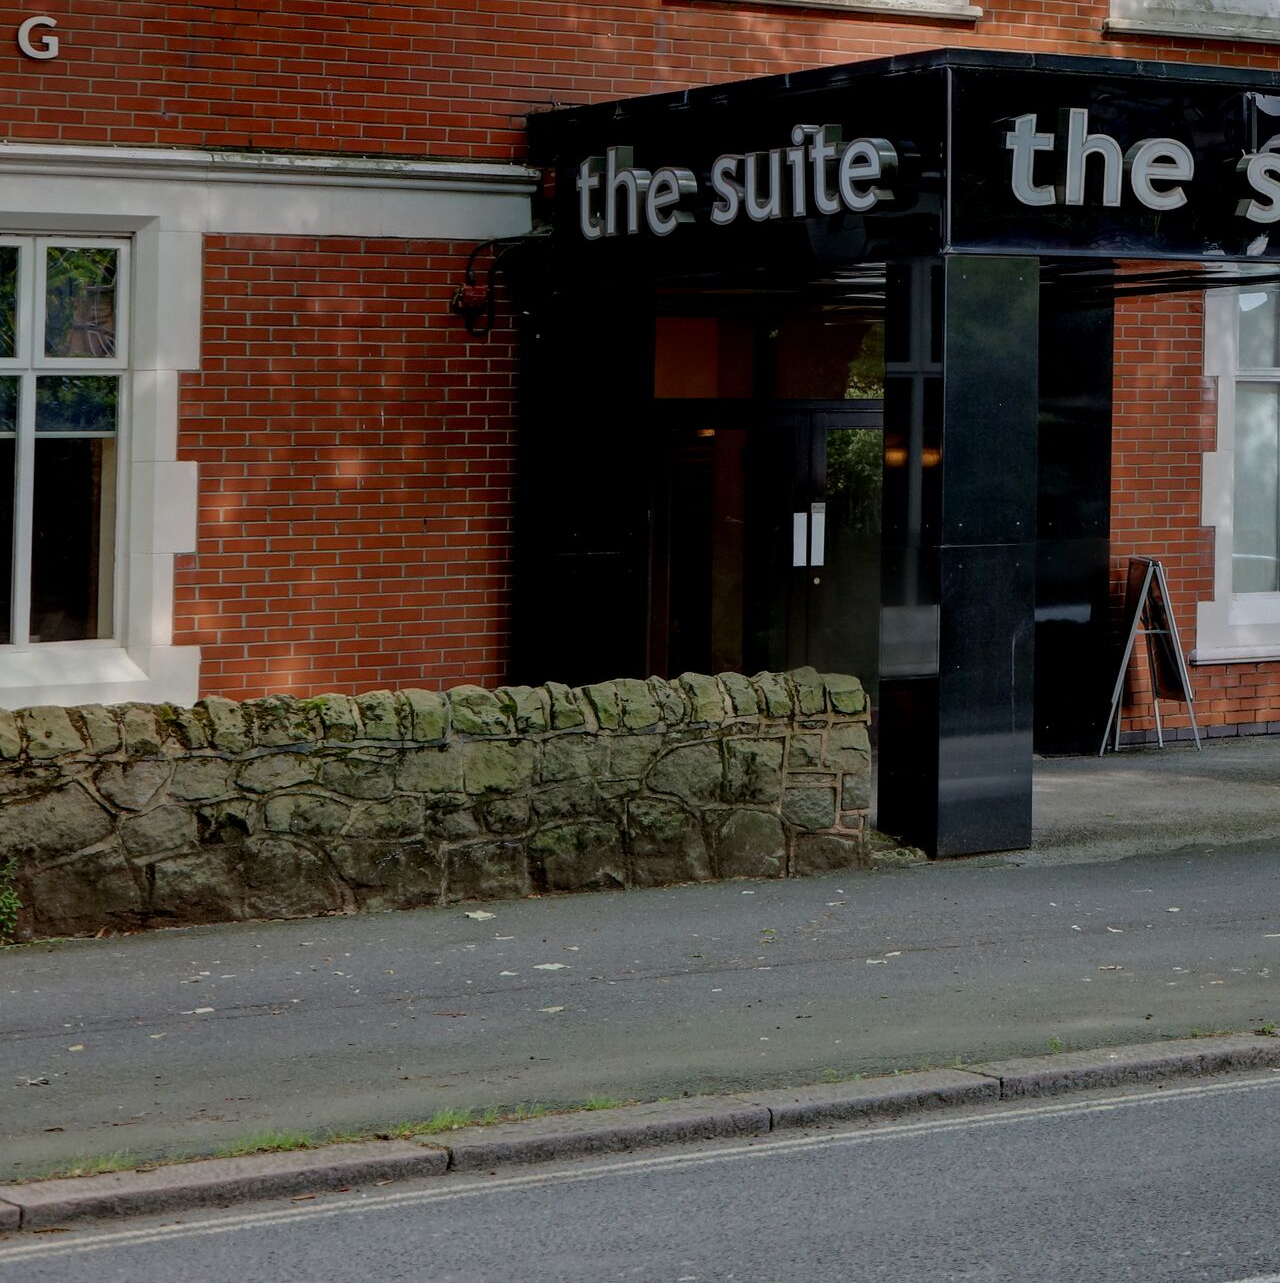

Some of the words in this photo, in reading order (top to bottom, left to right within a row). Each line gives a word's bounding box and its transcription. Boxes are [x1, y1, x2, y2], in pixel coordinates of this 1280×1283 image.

[17, 15, 60, 60] G
[574, 145, 697, 241] the
[710, 123, 899, 226] suite
[1005, 107, 1195, 212] the
